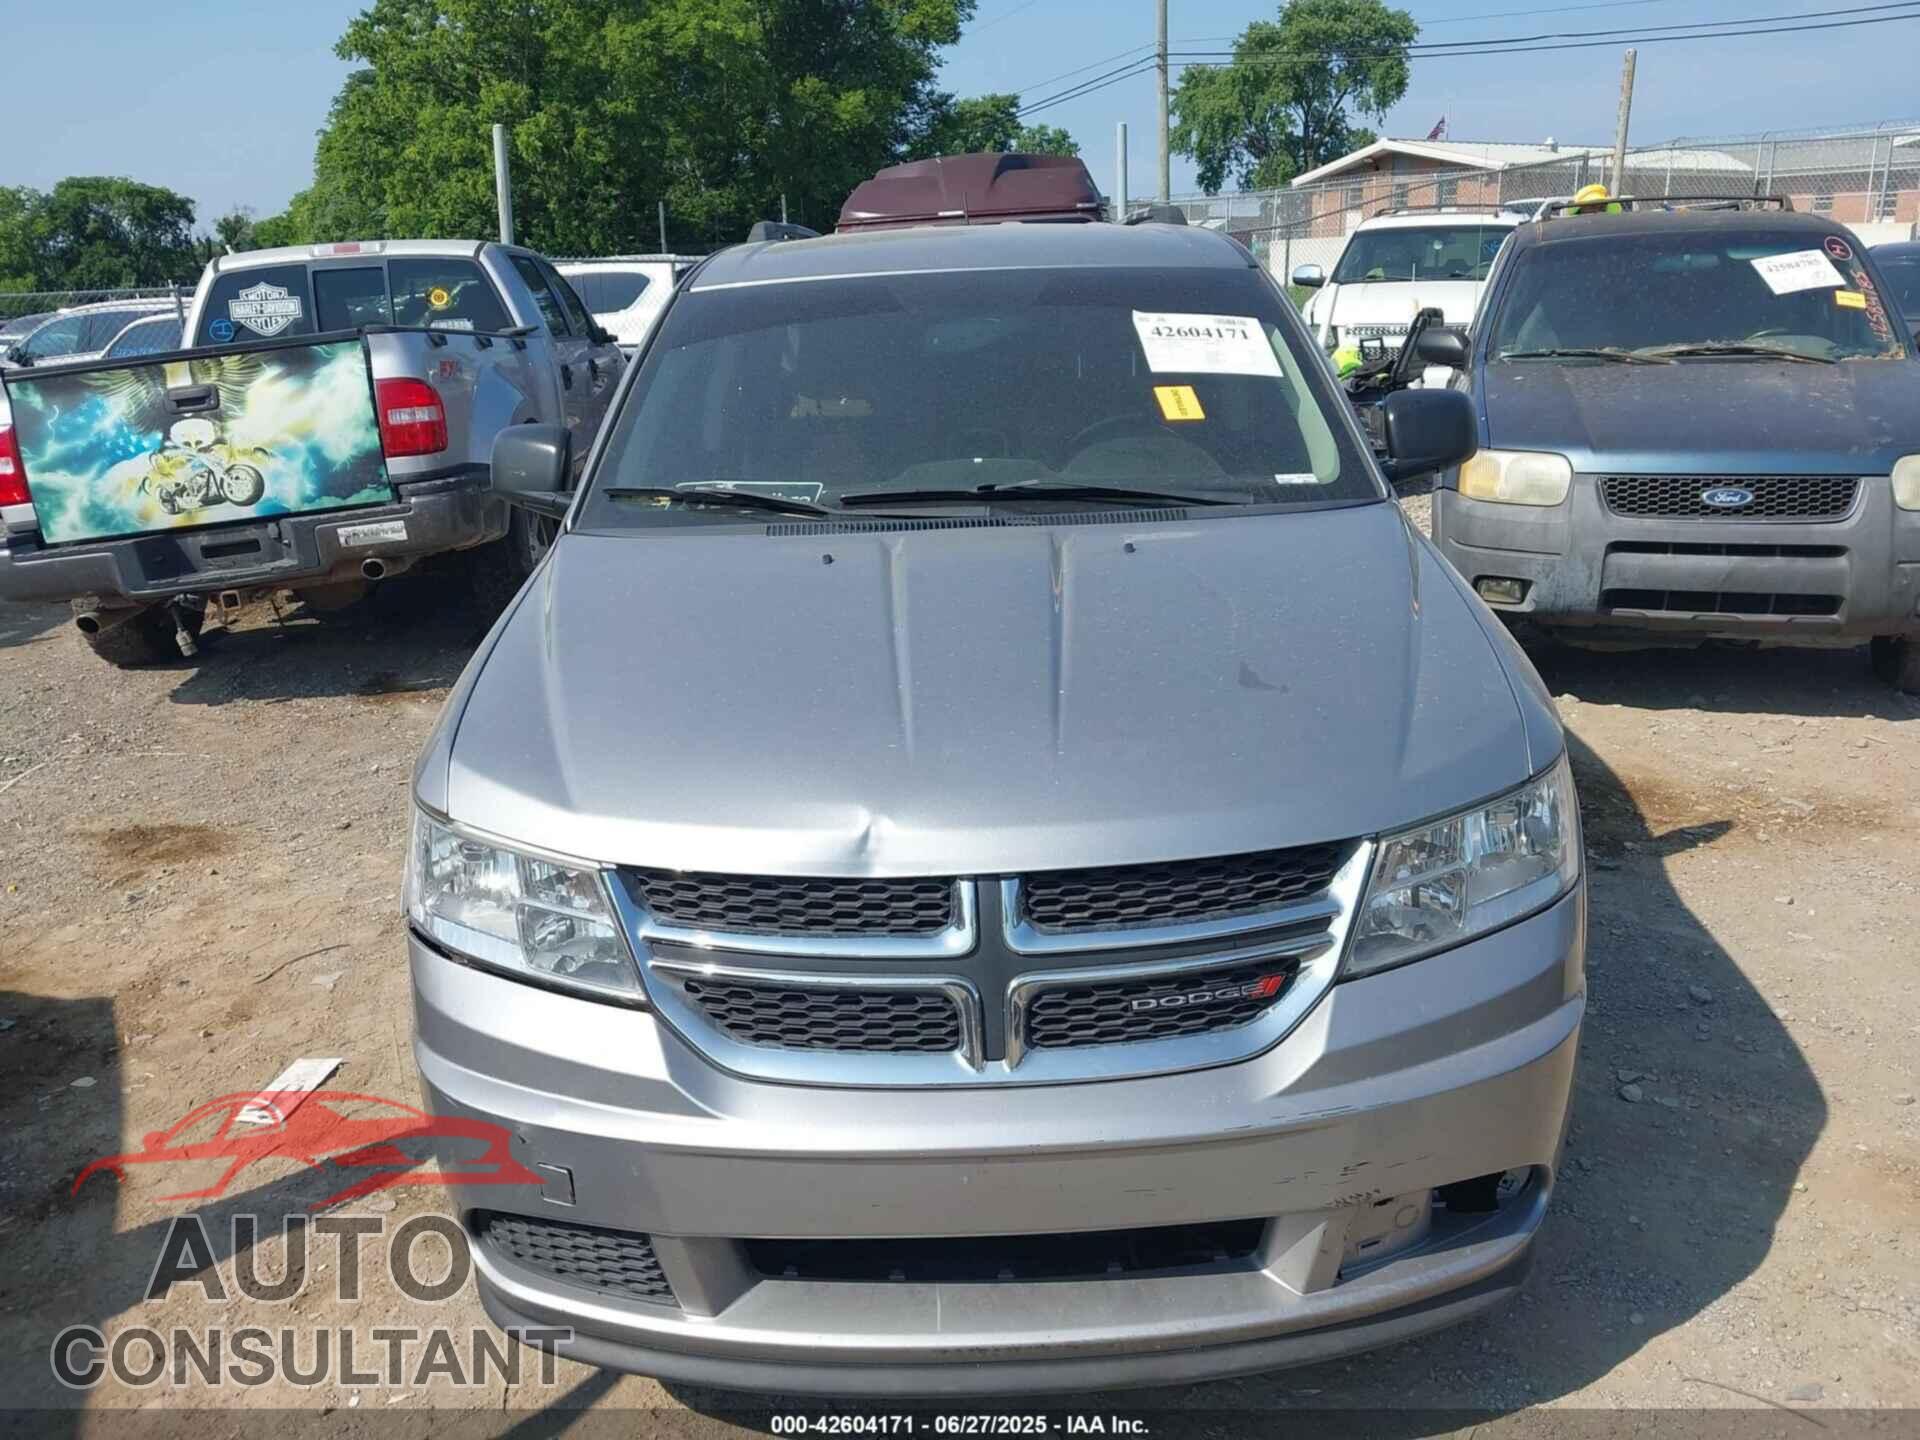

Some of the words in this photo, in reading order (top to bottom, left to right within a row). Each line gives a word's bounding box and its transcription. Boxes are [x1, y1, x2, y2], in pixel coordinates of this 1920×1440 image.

[243, 287, 286, 301] MOTOR
[232, 300, 298, 317] HARLEY-DAVIDSON
[1151, 326, 1249, 340] 42604171
[1131, 983, 1265, 1010] DODGE
